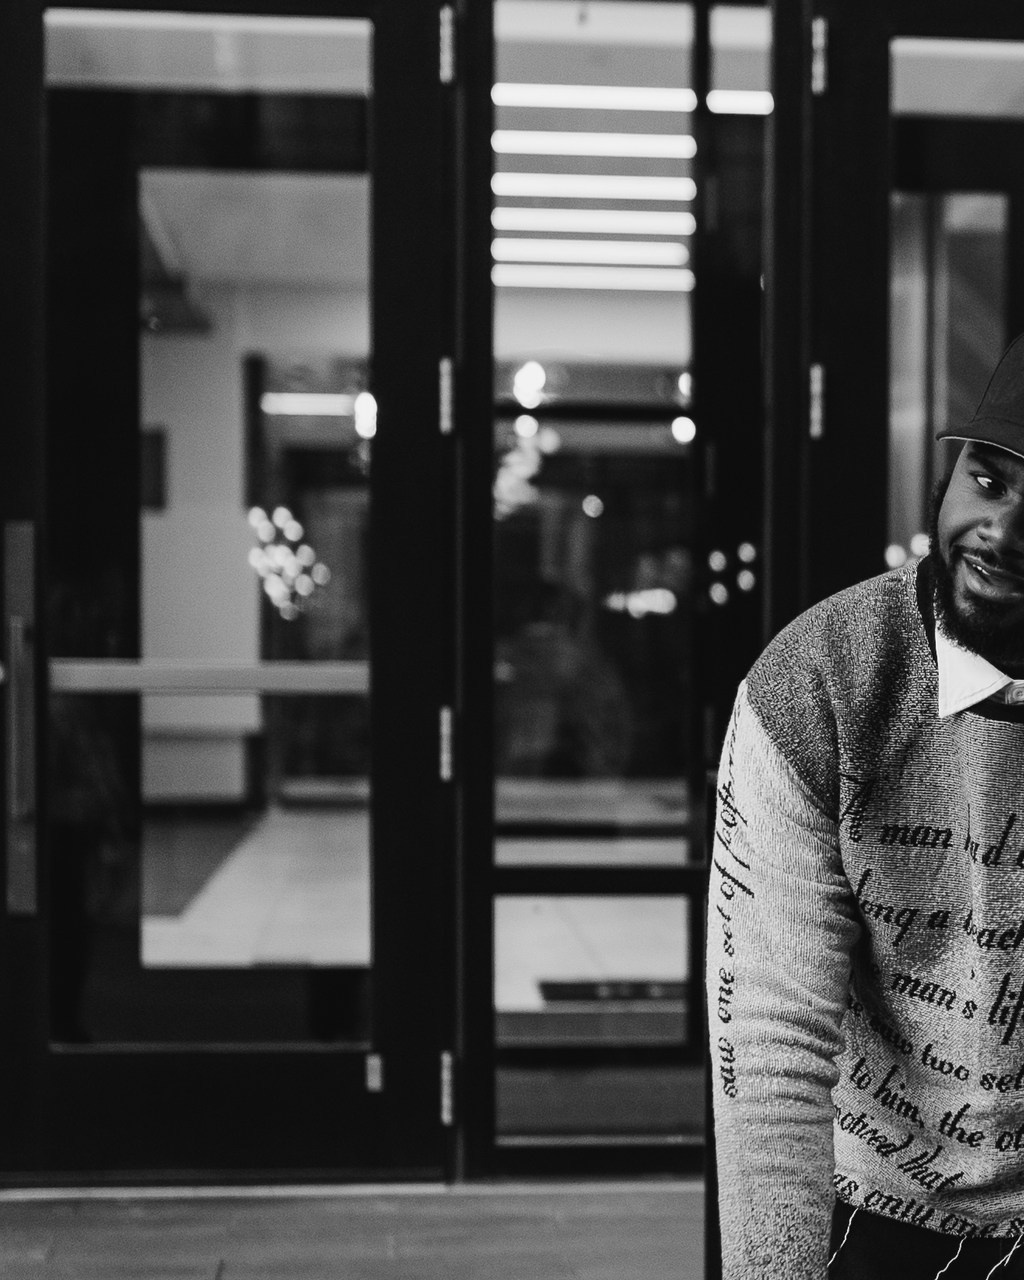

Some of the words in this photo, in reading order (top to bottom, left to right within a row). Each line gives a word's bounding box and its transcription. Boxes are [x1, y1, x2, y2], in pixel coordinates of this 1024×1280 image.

[880, 824, 953, 849] man
[714, 857, 755, 900] of
[716, 904, 735, 957] set
[927, 910, 951, 929] a
[717, 967, 735, 1023] one
[718, 1036, 739, 1099] saw
[921, 1043, 970, 1081] two
[850, 1057, 872, 1090] to
[939, 1103, 986, 1148] the
[898, 1145, 965, 1194] that
